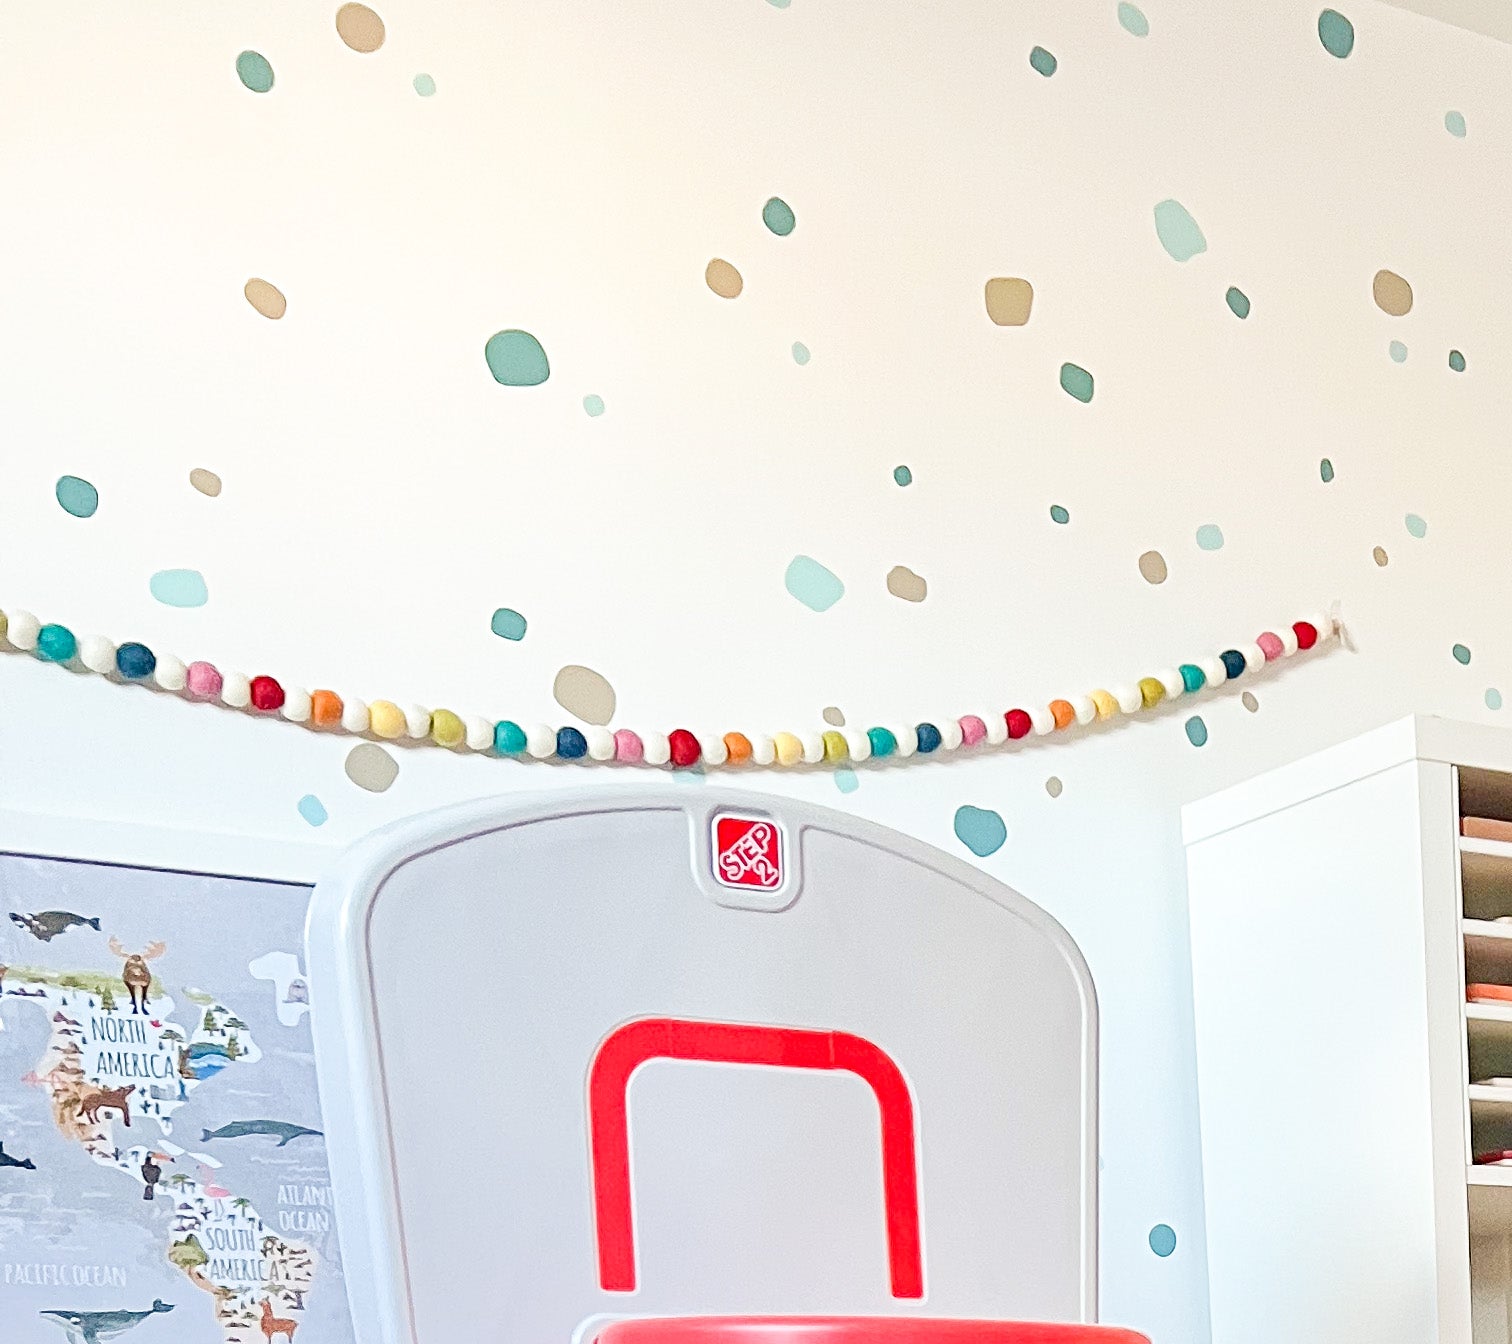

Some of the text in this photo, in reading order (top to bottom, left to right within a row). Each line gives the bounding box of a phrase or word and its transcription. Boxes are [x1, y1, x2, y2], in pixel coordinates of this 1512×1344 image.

[721, 824, 770, 879] STEP
[754, 856, 778, 884] 2
[91, 1016, 147, 1044] NORTH
[97, 1051, 175, 1078] AMERICA
[279, 1210, 329, 1232] OCEAN
[206, 1227, 256, 1251] SOUTH
[5, 1263, 126, 1287] PACIFIC OCEAN
[210, 1258, 280, 1281] AMERICA
